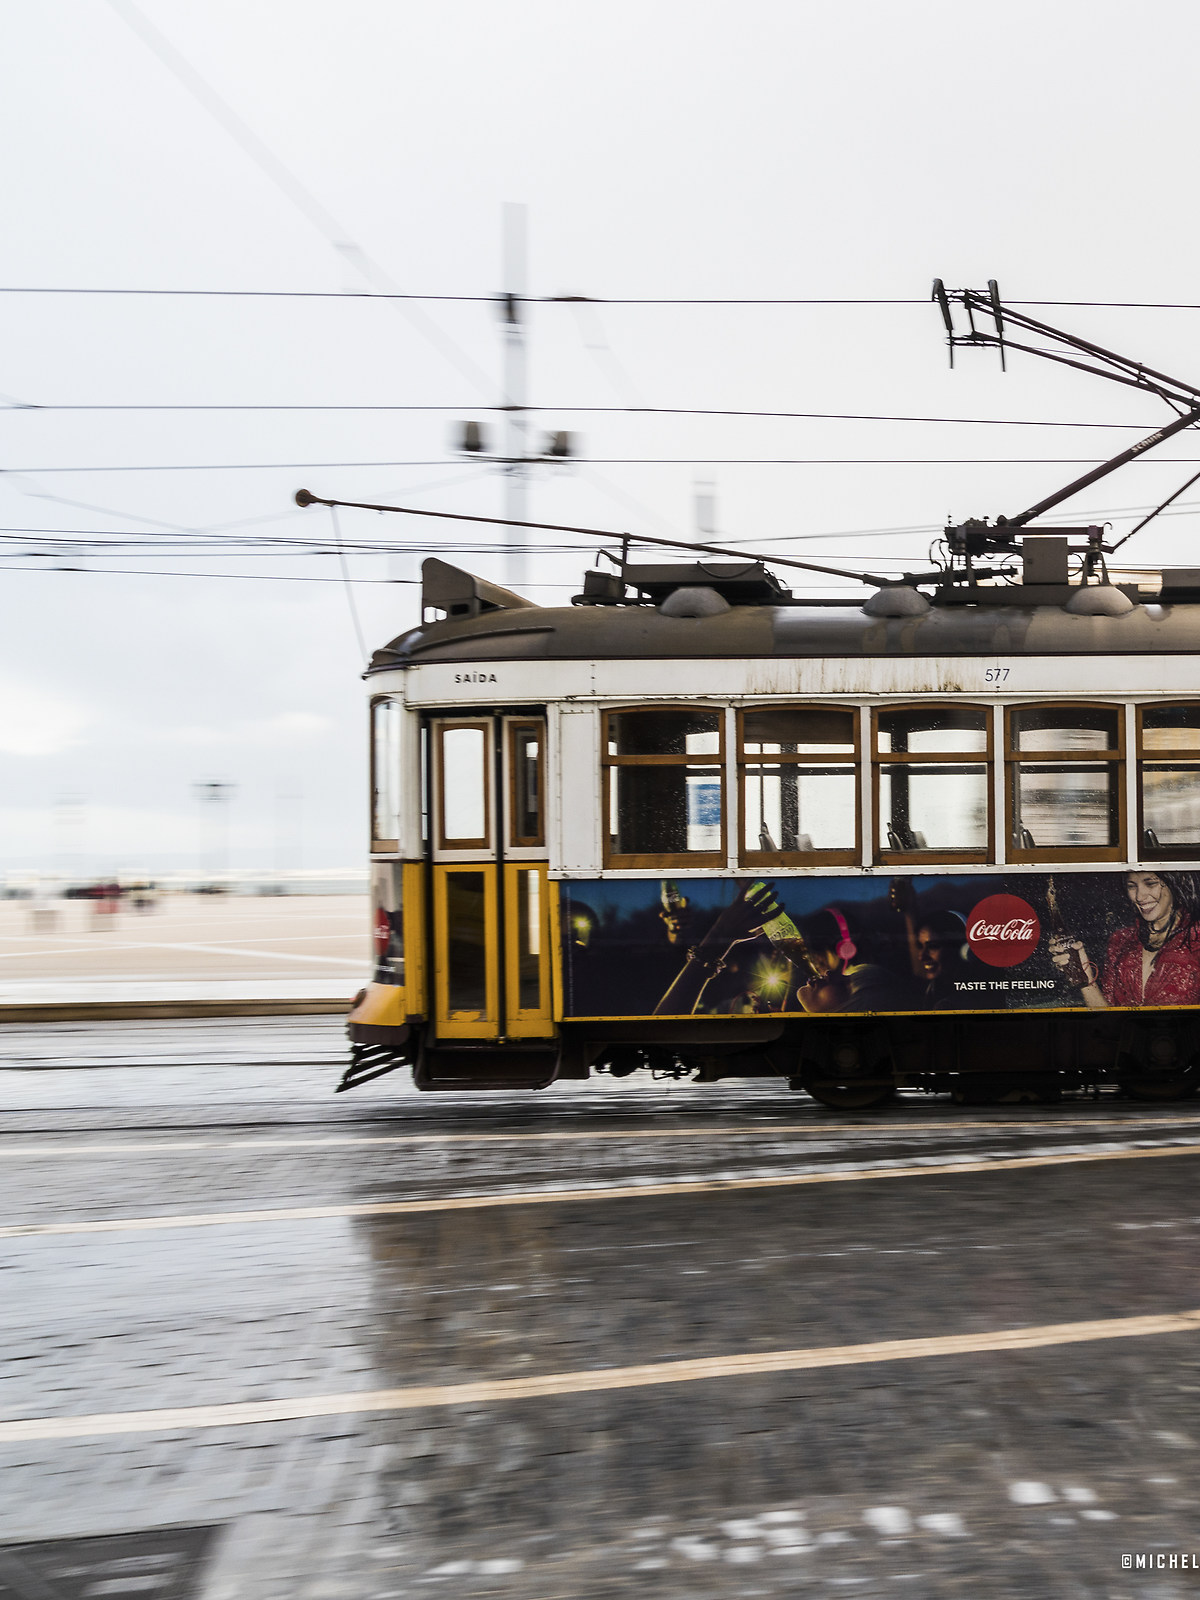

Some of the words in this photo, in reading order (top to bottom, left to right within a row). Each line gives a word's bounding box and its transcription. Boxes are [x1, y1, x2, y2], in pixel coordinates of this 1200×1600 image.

[984, 668, 1010, 682] 577
[969, 918, 1037, 942] Coca-Cola
[953, 981, 987, 991] TASTE
[988, 981, 1010, 990] THE
[1011, 979, 1055, 990] FEELING
